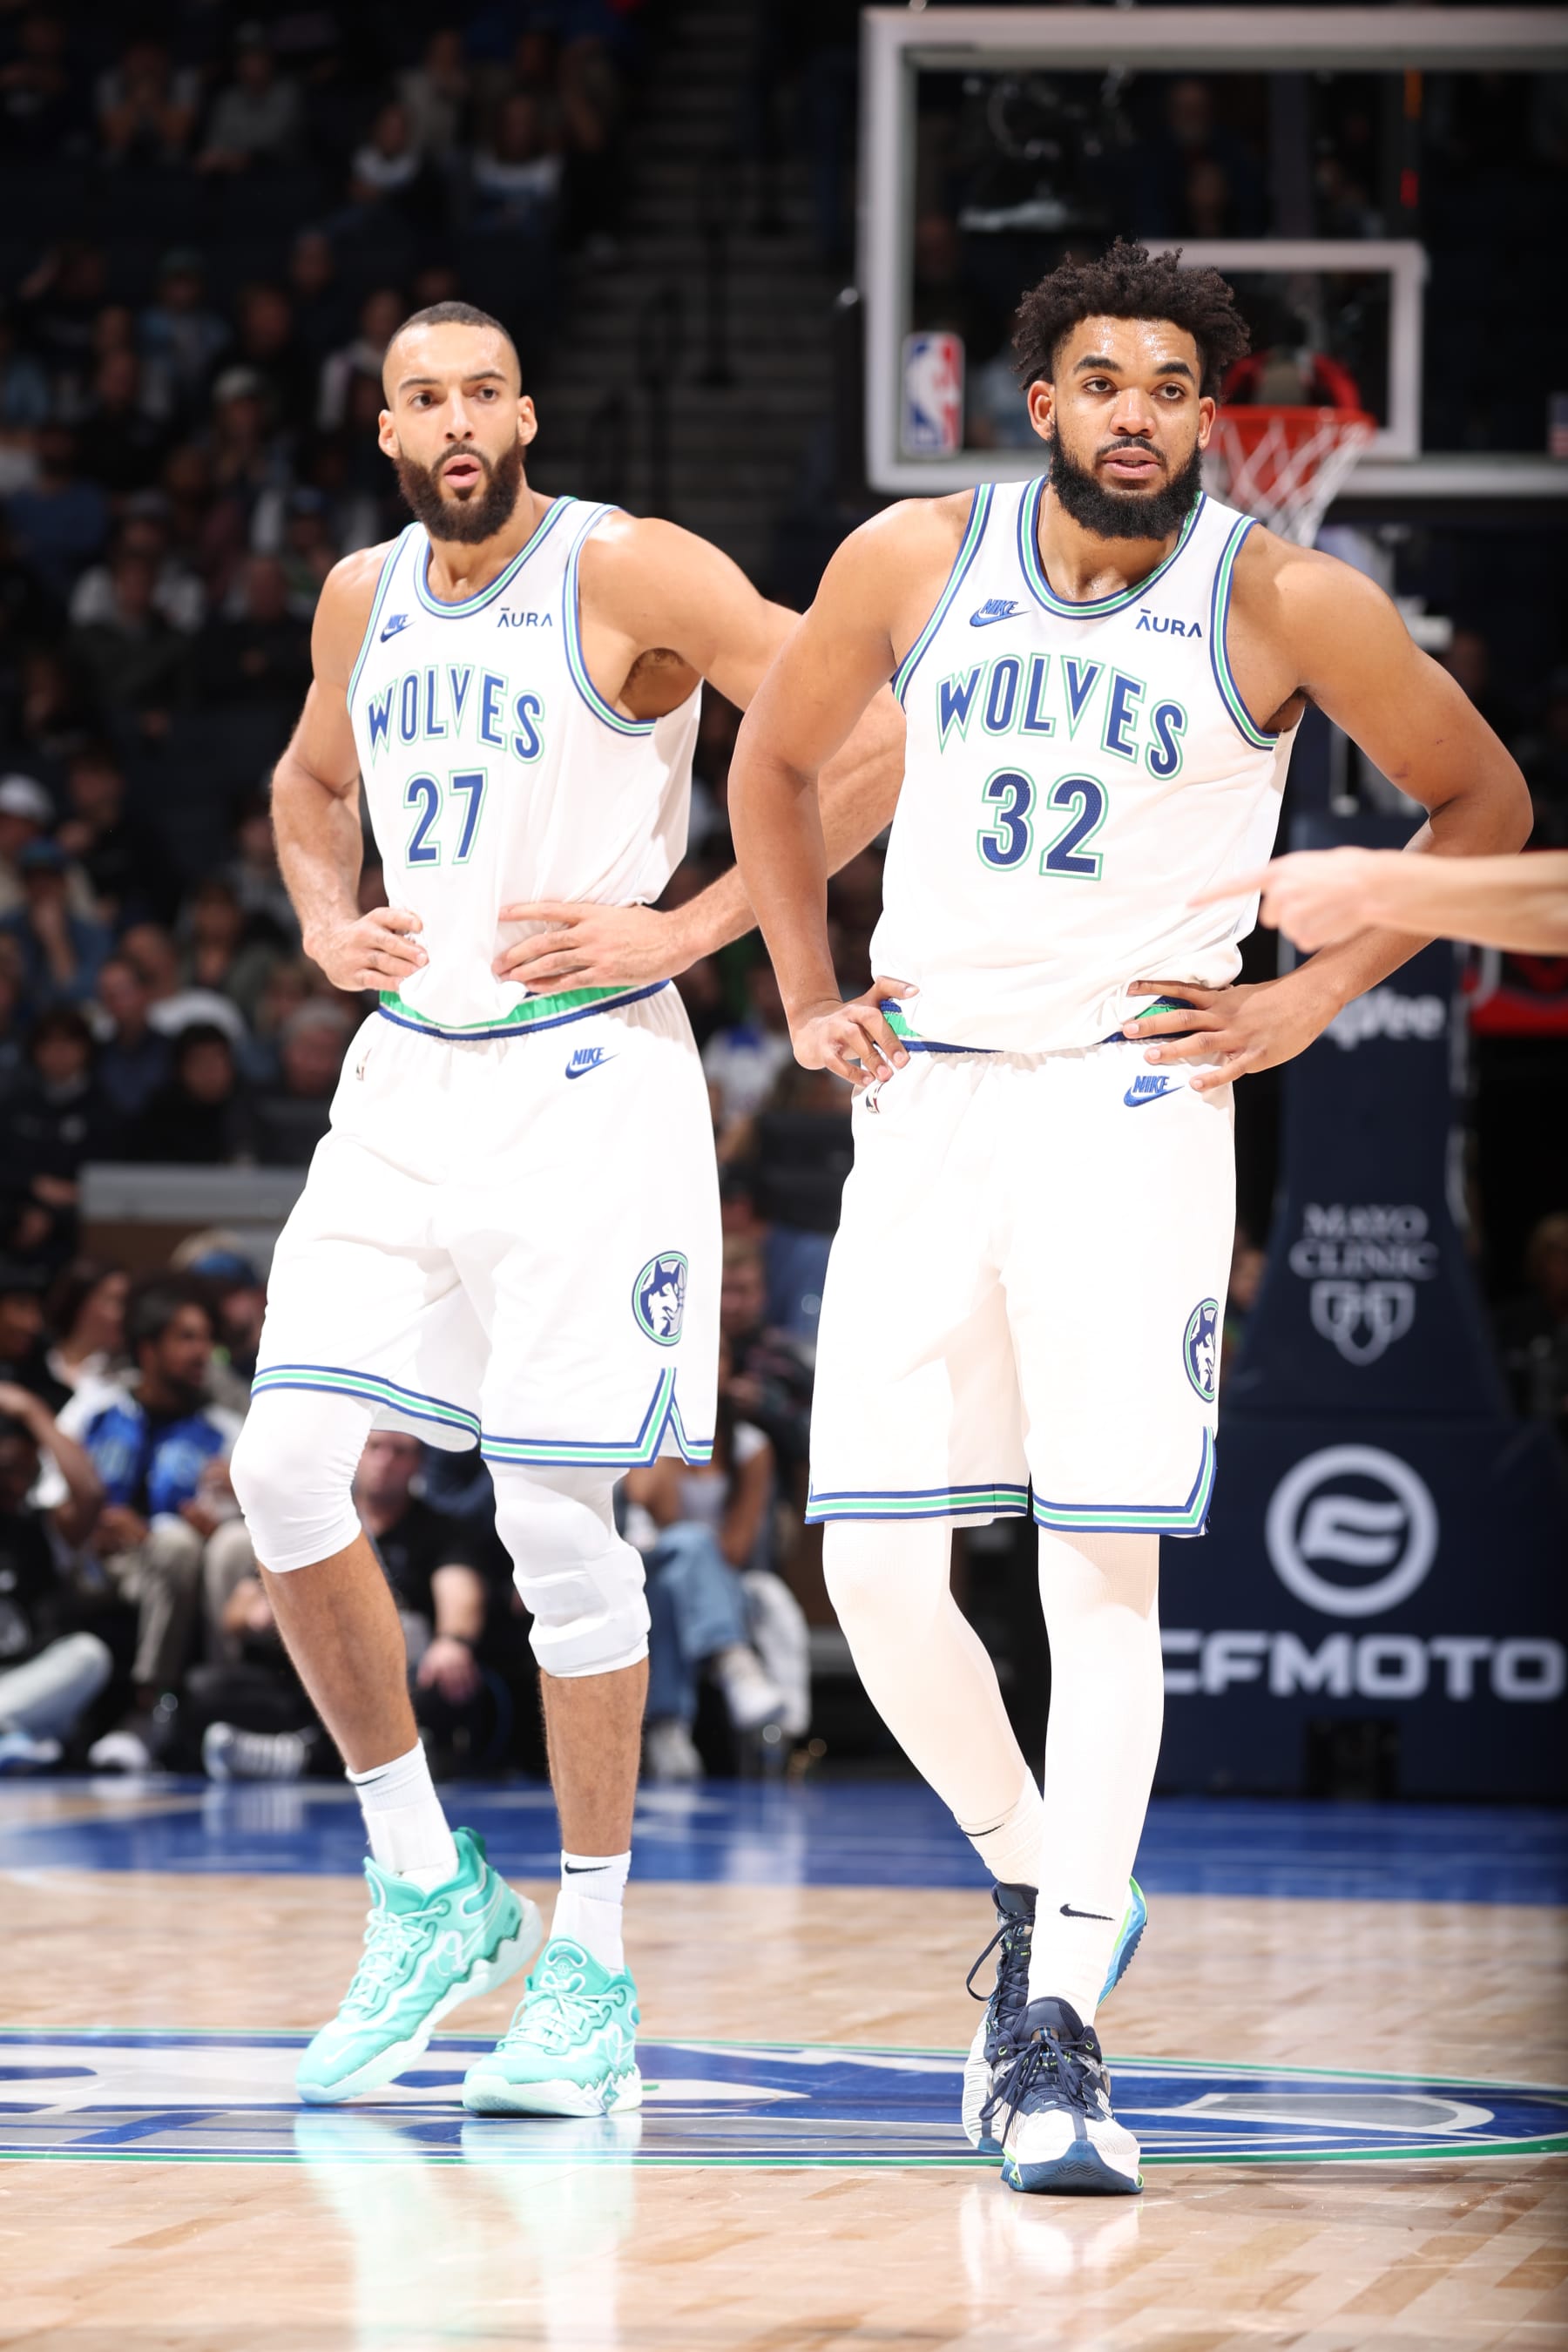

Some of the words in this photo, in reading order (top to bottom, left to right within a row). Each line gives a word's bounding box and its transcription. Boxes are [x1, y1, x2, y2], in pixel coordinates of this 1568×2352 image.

[385, 613, 409, 630] NIKE
[980, 598, 1018, 616] NIKE
[366, 663, 545, 766] WOLVES
[936, 652, 1188, 781] WOLVES
[403, 767, 488, 868] 27
[977, 767, 1109, 881] 32
[571, 1046, 605, 1065] NIKE
[1132, 1075, 1170, 1093] NIKE
[1304, 1203, 1429, 1240] MAYO
[1288, 1240, 1438, 1281] CLINIC
[1159, 1628, 1565, 1702] CFMOTO
